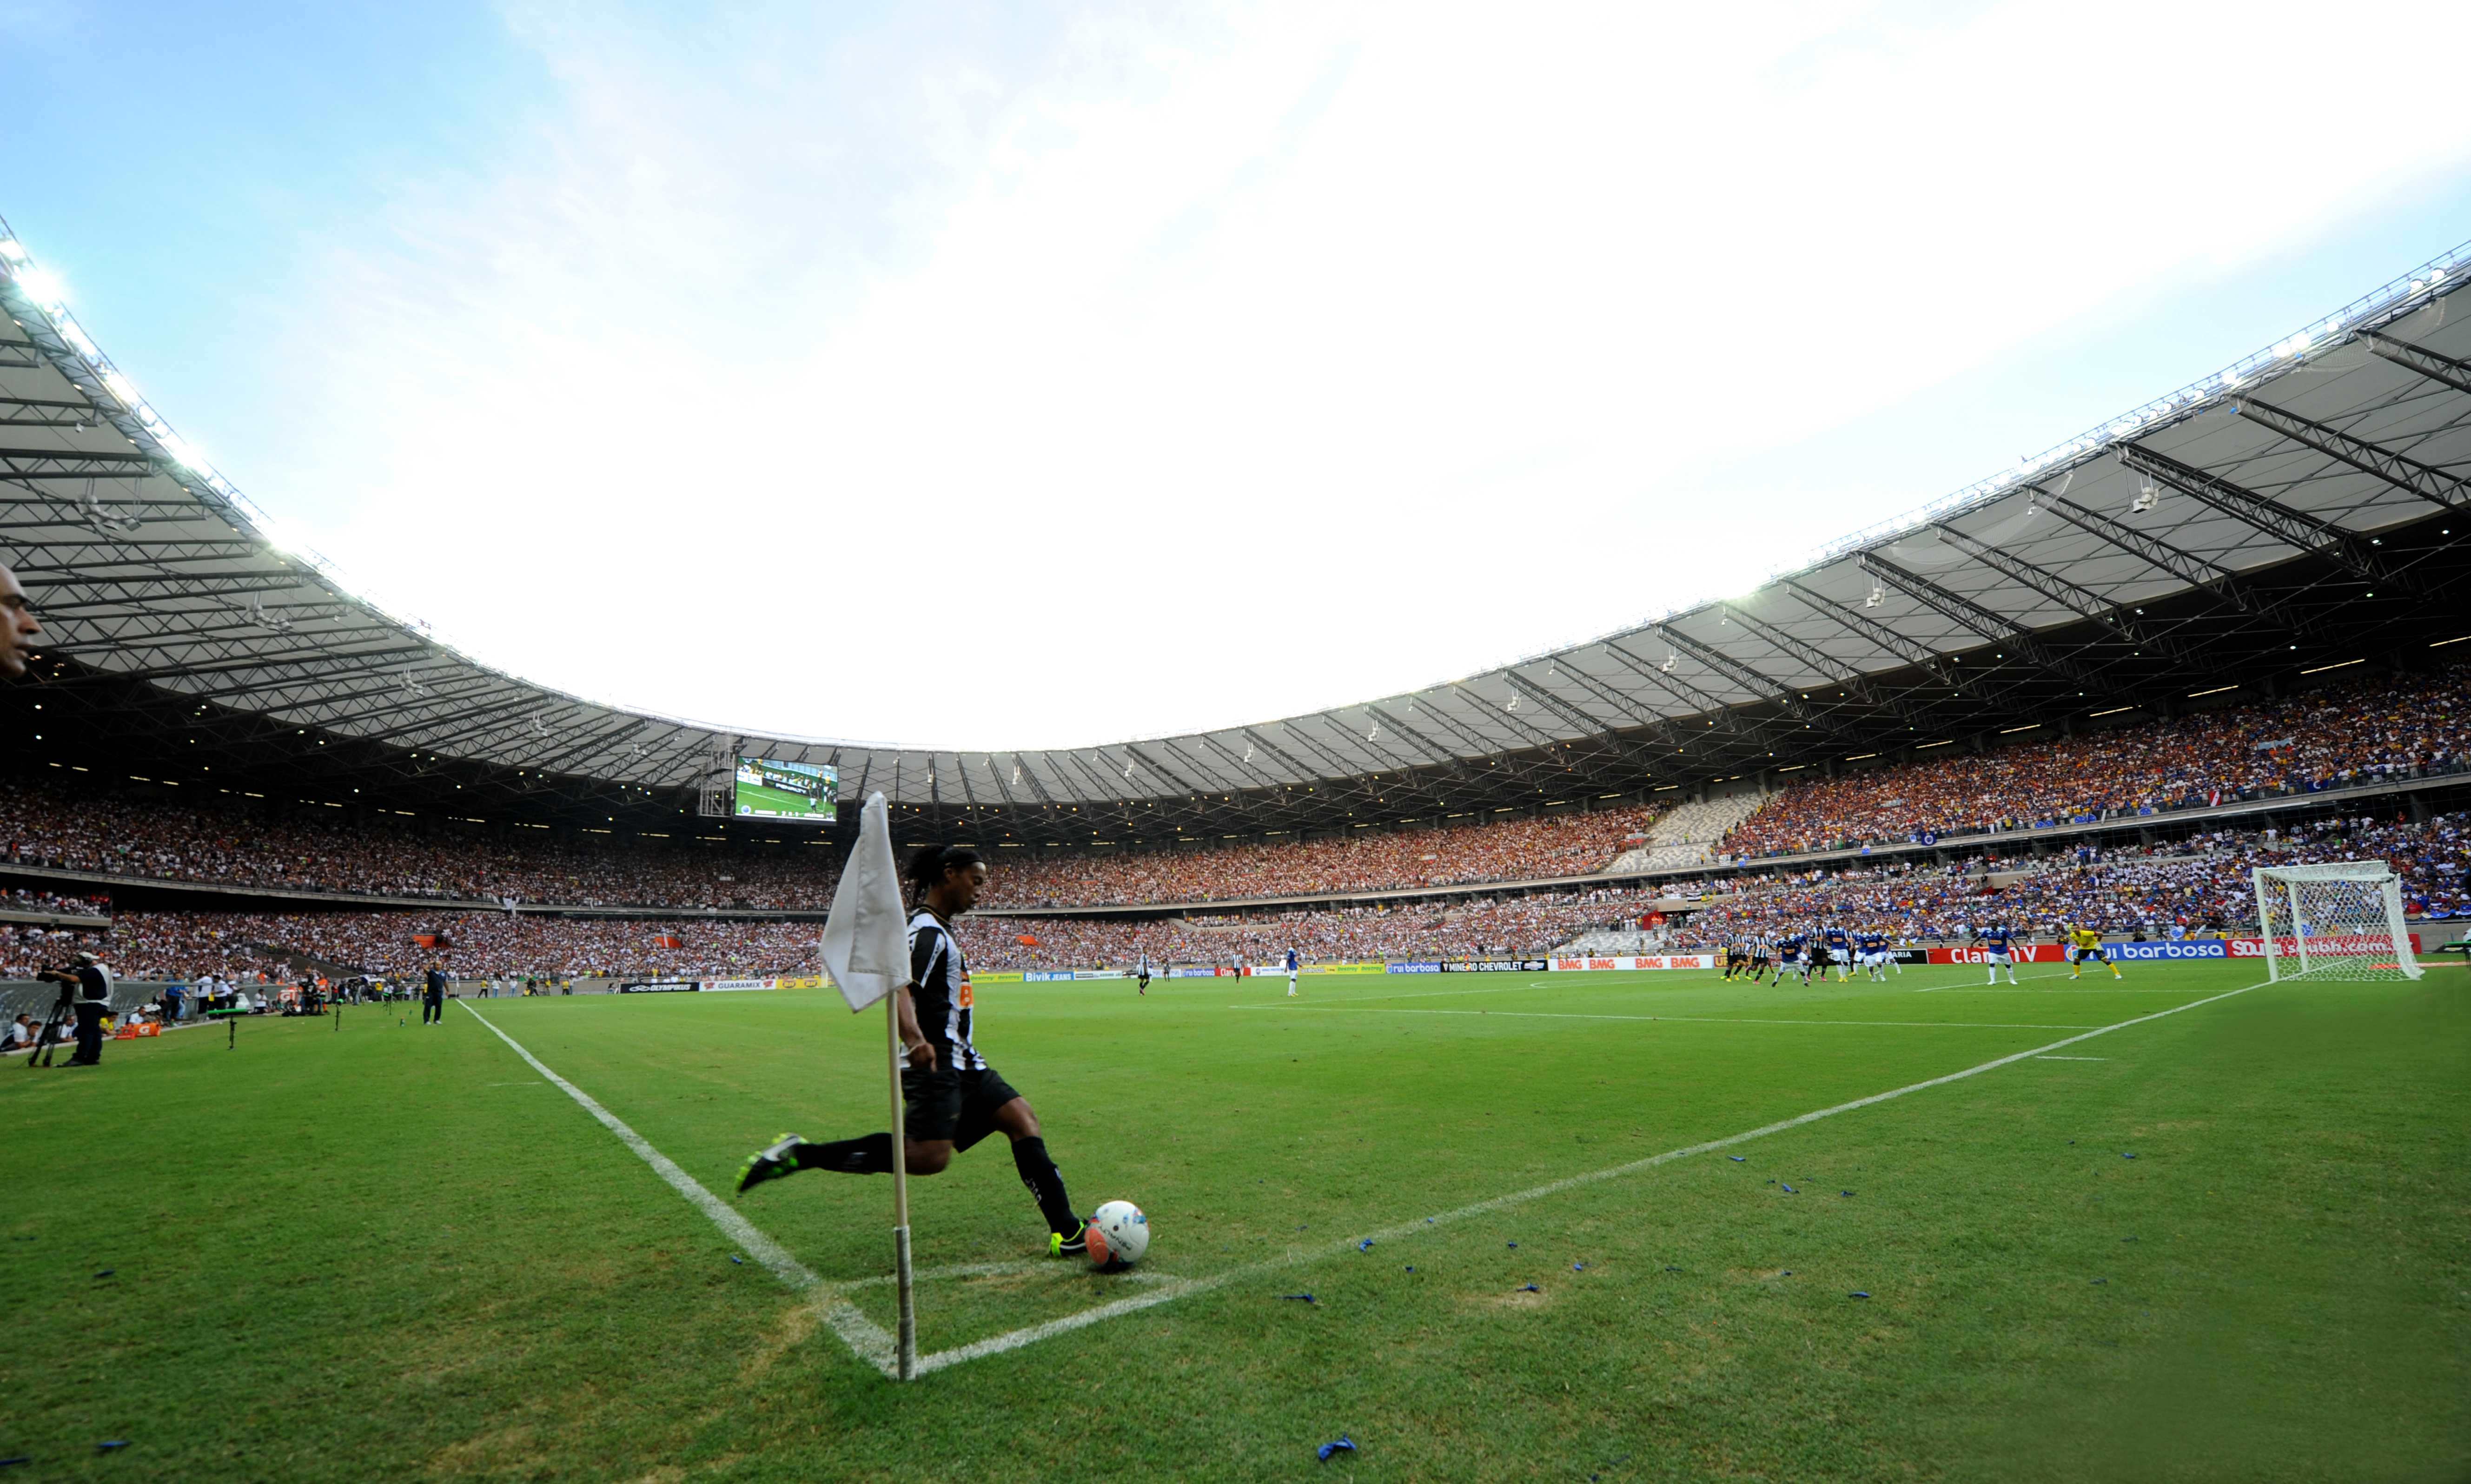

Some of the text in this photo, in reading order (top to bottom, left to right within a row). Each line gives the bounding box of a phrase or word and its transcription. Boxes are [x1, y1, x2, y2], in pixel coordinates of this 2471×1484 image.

[2123, 942, 2224, 958] barbosa
[1951, 948, 1994, 963] Clar
[1449, 961, 1523, 972] MINERO CHEVROLET
[1558, 959, 1583, 969] BMG
[1589, 959, 1615, 969] BMG
[1636, 958, 1663, 968] BMG
[1671, 957, 1700, 967] BMG
[1405, 963, 1439, 972] barbosa
[1026, 972, 1051, 982] Bivik
